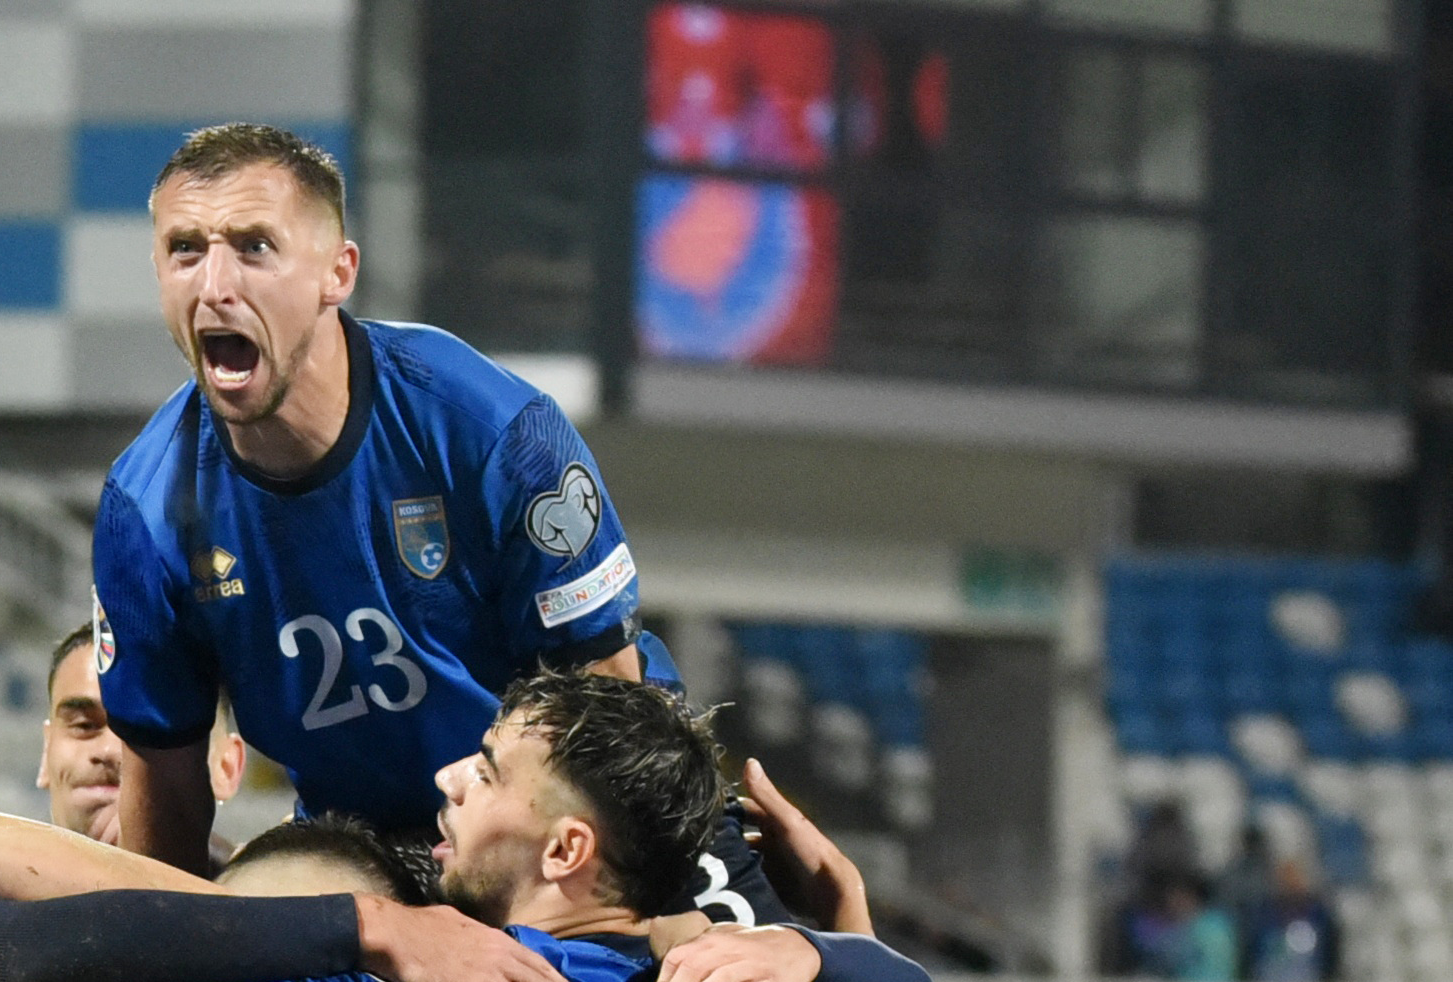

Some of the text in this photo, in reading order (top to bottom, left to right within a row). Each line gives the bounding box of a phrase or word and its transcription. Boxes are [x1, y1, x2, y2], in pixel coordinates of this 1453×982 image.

[398, 503, 439, 517] KOSOVA
[540, 554, 631, 617] FOUNDATION
[279, 607, 427, 731] 23
